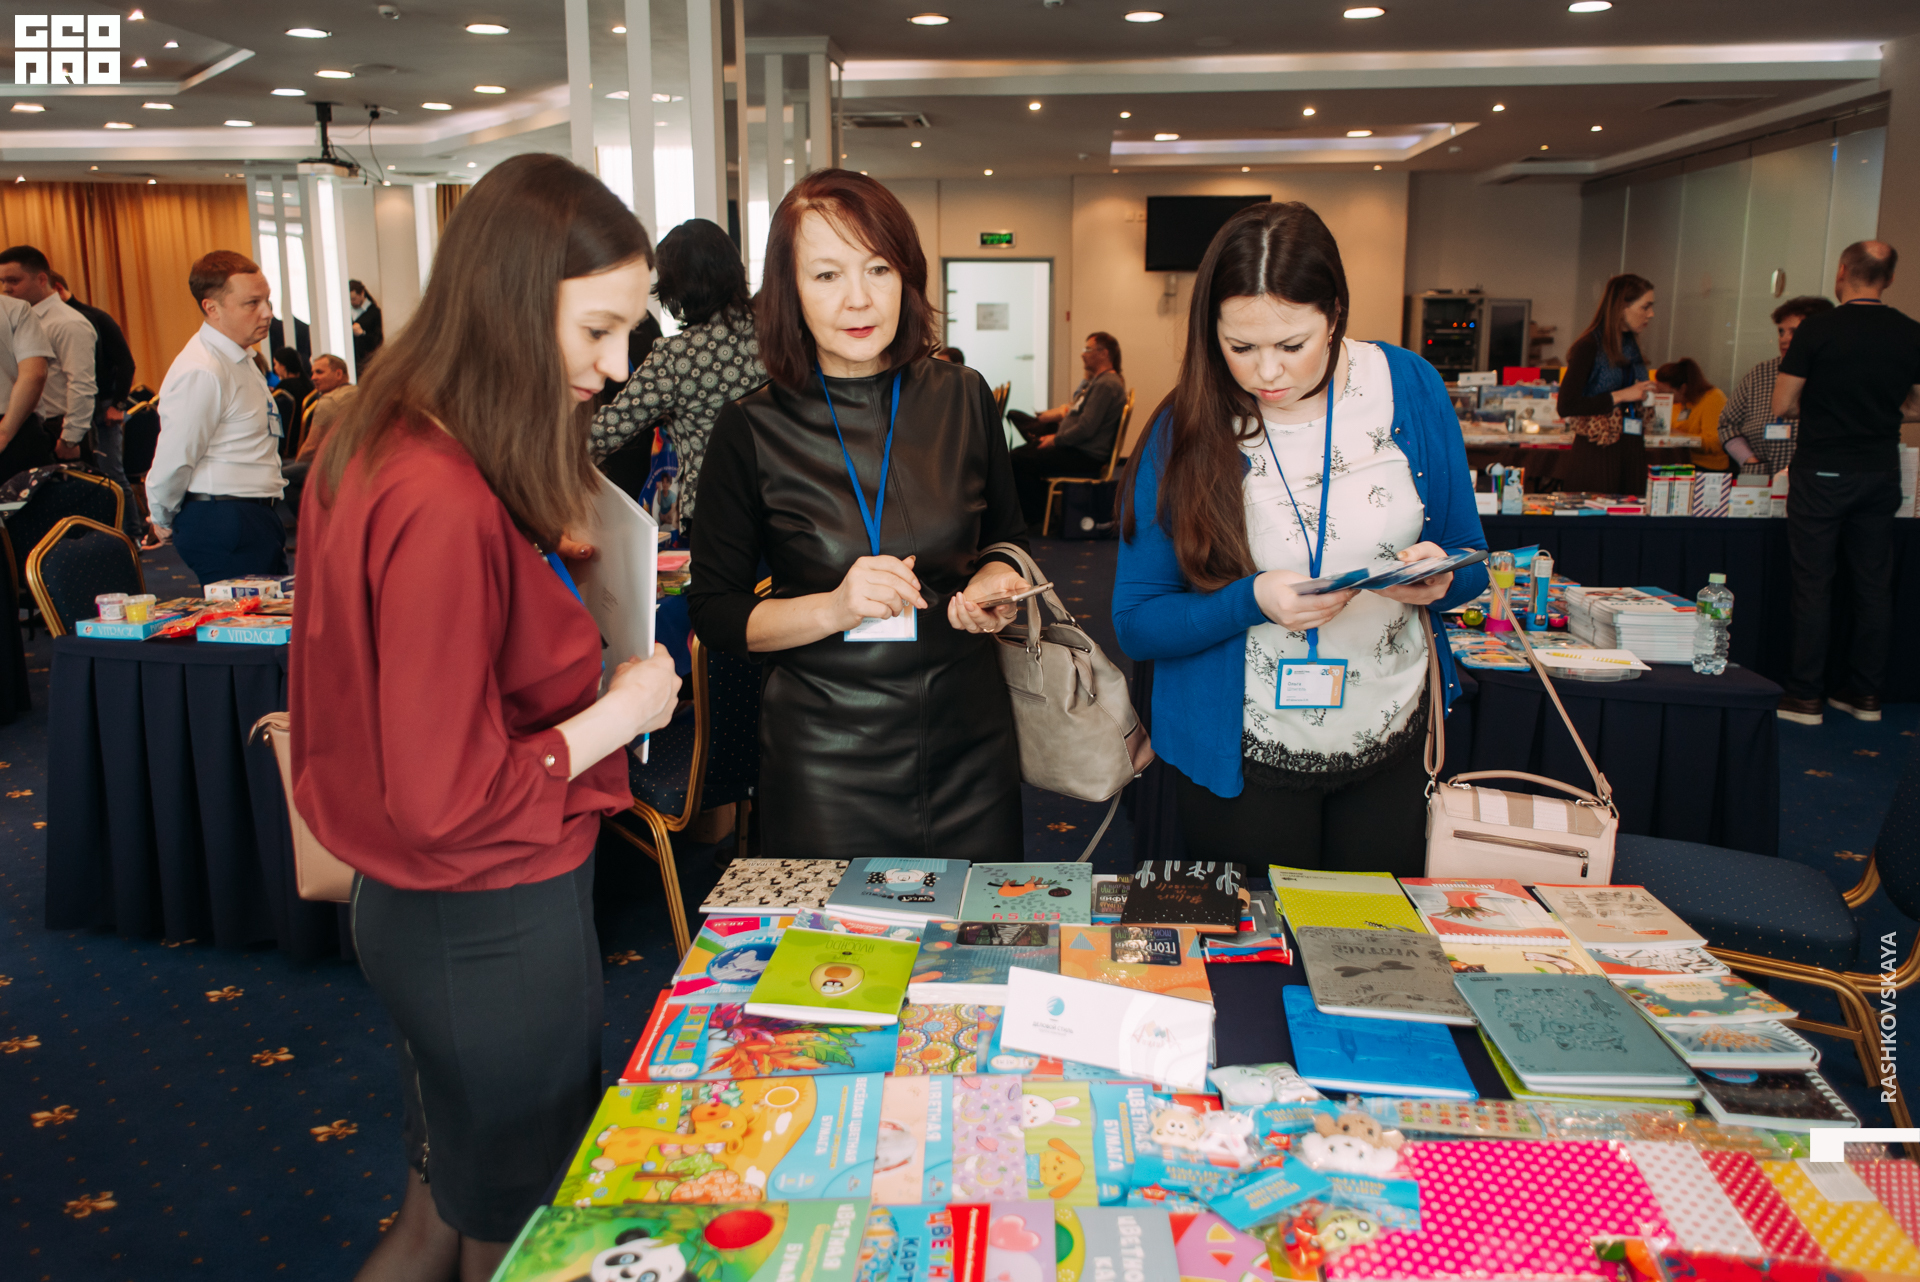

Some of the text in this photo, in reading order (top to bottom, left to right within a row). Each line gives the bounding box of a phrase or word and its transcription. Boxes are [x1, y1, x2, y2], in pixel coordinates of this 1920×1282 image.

[97, 625, 135, 638] VITRAGE
[227, 629, 276, 644] VITRAGE
[825, 940, 875, 953] AVOCADO
[1331, 944, 1420, 958] VINTAGE
[654, 1034, 674, 1062] БУМАГА
[669, 1003, 711, 1060] ВЕТНАЯ
[844, 1077, 868, 1163] ВЕСЁЛАЯ ЦВЕТНАЯ
[925, 1081, 942, 1141] ЦВЕТНАЯ
[1126, 1088, 1152, 1153] ЦВЕТНАЯ
[815, 1115, 833, 1155] БУМАГА
[1103, 1119, 1124, 1171] БУМАГА
[926, 1208, 953, 1282] ЦВЕТН
